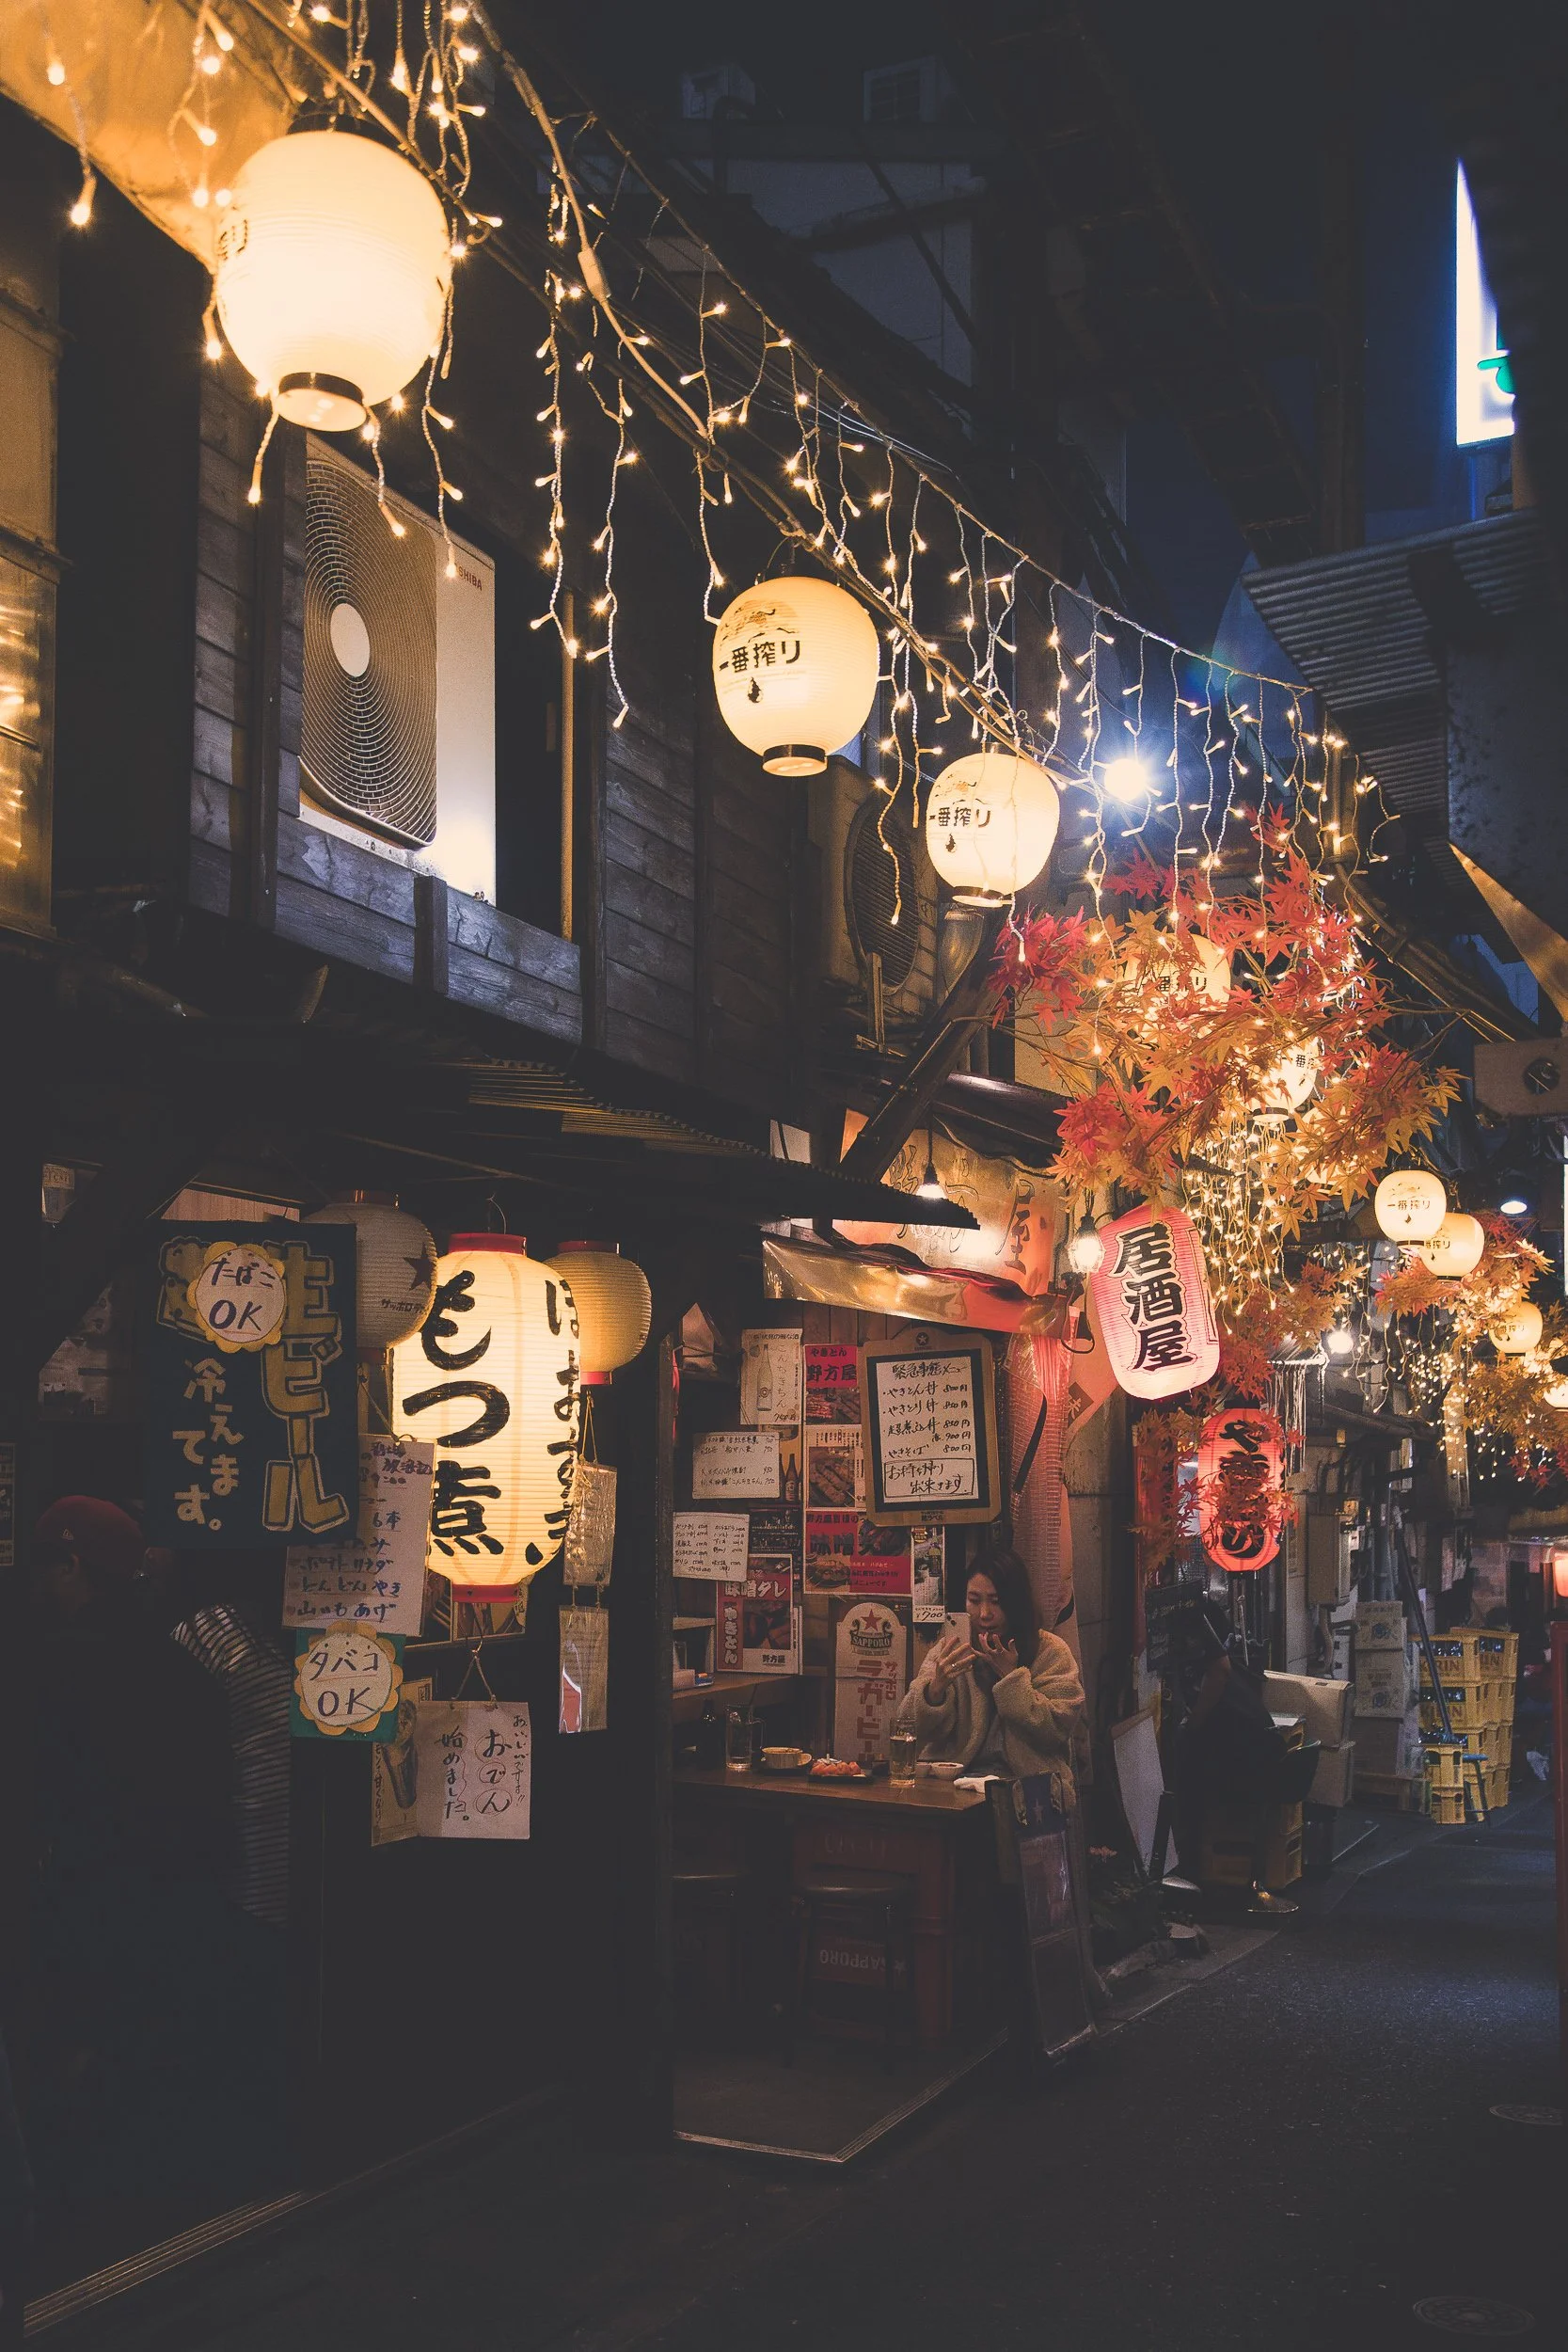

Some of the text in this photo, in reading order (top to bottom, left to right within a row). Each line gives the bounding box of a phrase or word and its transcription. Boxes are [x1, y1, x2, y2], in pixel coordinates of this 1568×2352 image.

[718, 639, 800, 674] 一番搾り
[927, 805, 991, 829] 一番搾り
[1387, 1199, 1432, 1212] 一番搾り
[208, 1256, 277, 1289] たばこ
[1113, 1222, 1195, 1371] 居酒屋
[207, 1298, 264, 1333] OK
[806, 1363, 857, 1382] 野方屋
[723, 1580, 787, 1598] 味噌タレ
[722, 1606, 739, 1665] やきとん
[852, 1635, 892, 1648] SAPPORO
[309, 1649, 380, 1681] タバコ
[884, 1661, 899, 1701] サッポロ
[316, 1690, 376, 1718] OK
[483, 1728, 513, 1815] おでん
